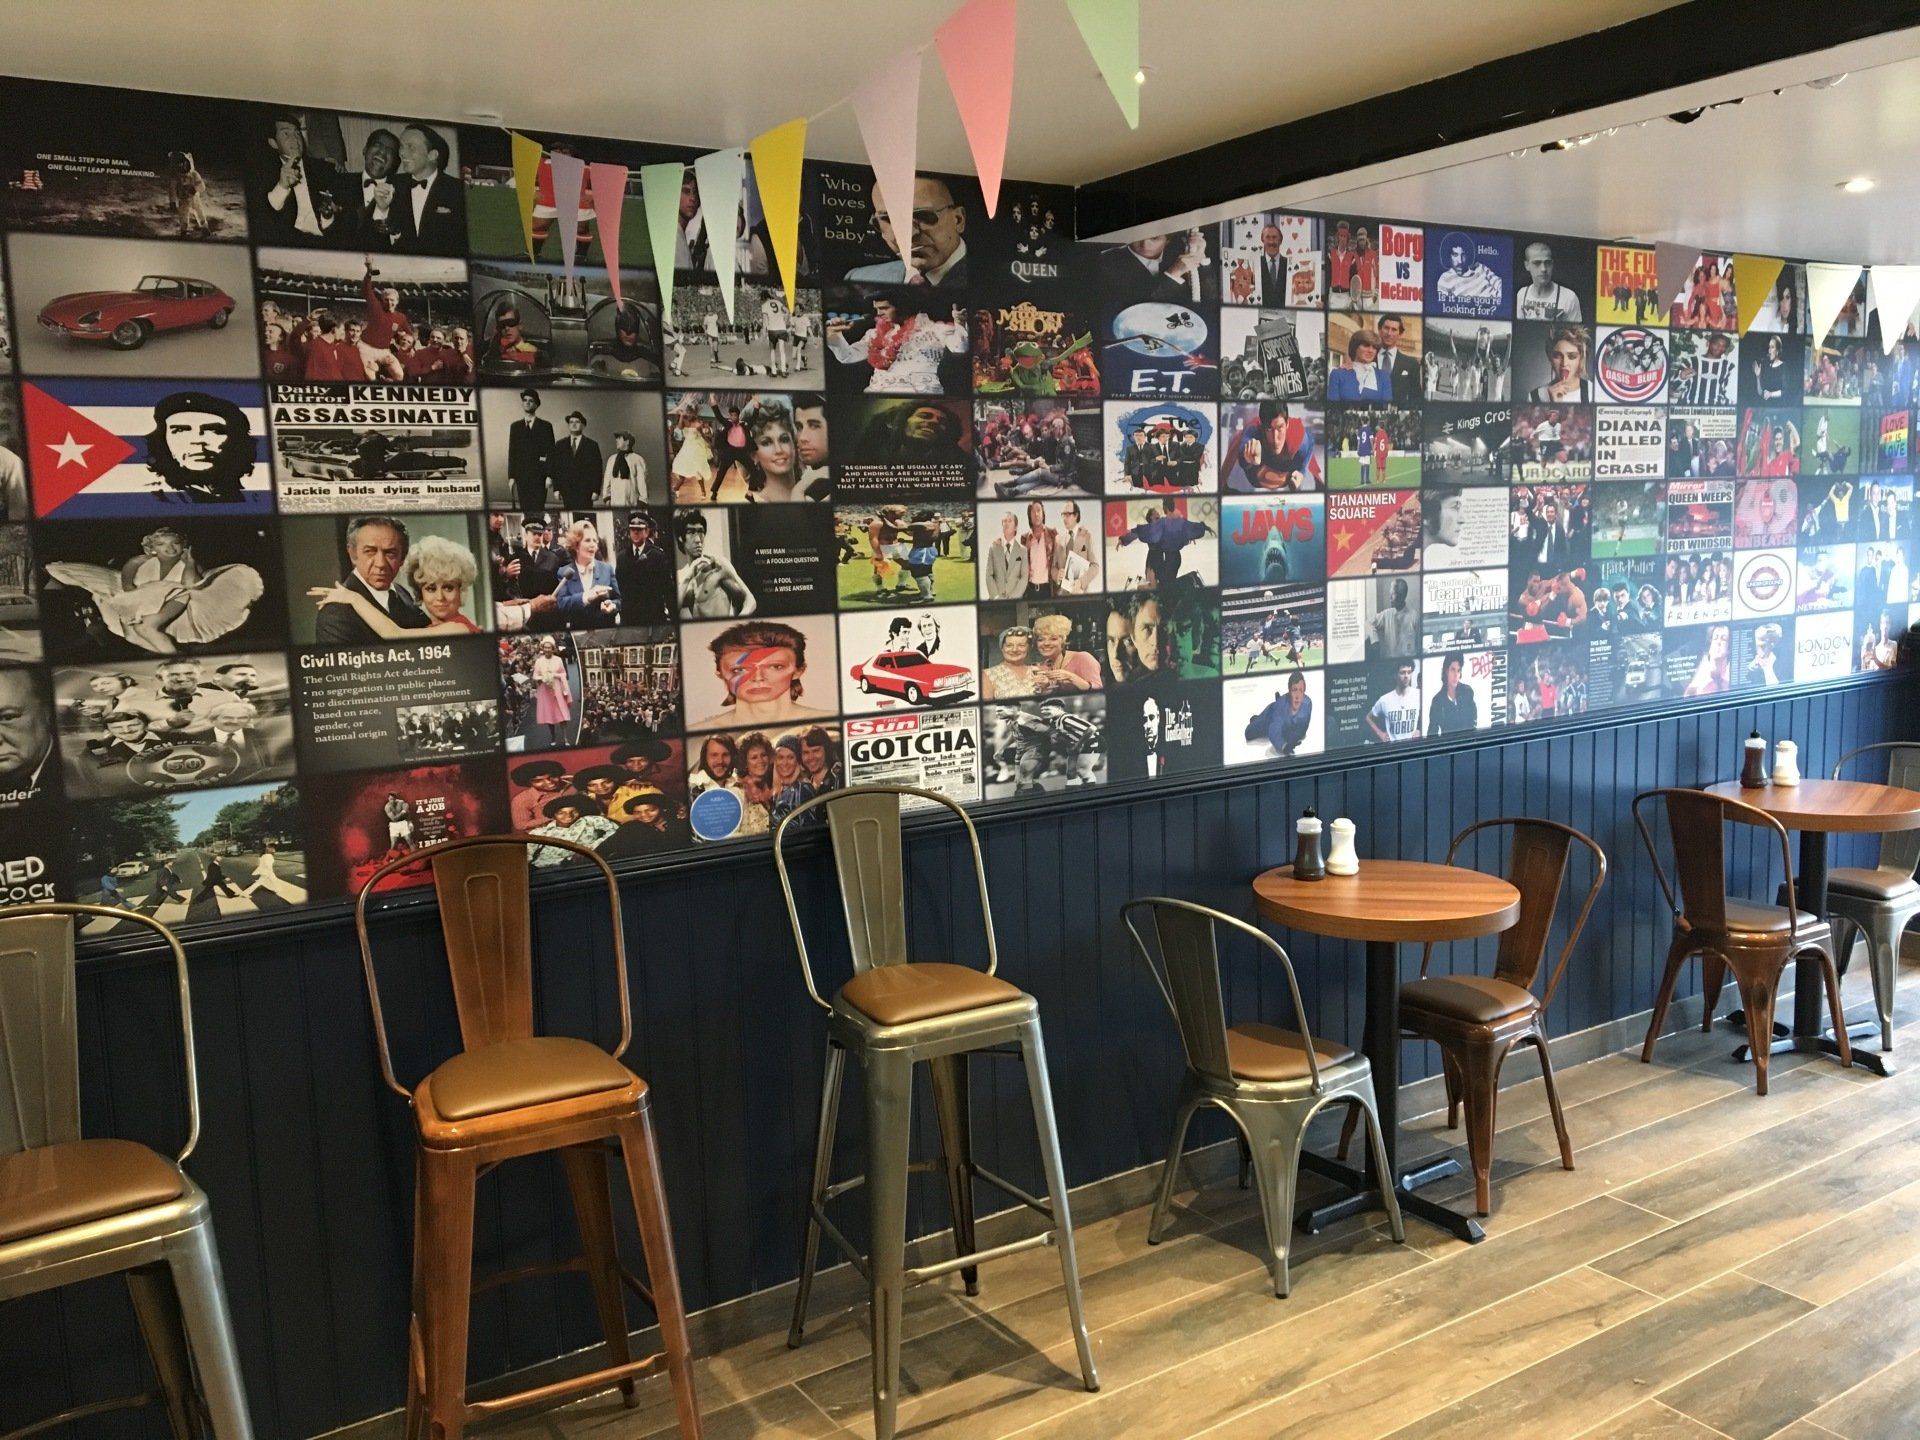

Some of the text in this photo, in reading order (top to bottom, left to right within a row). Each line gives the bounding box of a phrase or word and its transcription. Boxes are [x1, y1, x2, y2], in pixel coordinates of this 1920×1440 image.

[53, 154, 77, 163] SMALL
[78, 156, 95, 164] STEP
[111, 159, 130, 167] MAN,
[47, 163, 63, 171] ONE
[64, 164, 87, 173] GIANT
[87, 166, 106, 174] LEAP
[822, 193, 866, 209] loves
[835, 214, 854, 226] ya
[1381, 225, 1424, 262] Borg
[1477, 245, 1500, 256] Hello.
[1600, 248, 1630, 272] THE
[1011, 260, 1058, 283] QUEEN
[1438, 291, 1502, 307] Is it me you're
[1442, 303, 1497, 316] looking for?
[1262, 333, 1297, 361] SUPPORT
[1276, 356, 1295, 374] THE
[1130, 368, 1197, 394] E.T.
[1605, 369, 1631, 385] OASIS
[1637, 370, 1658, 384] BLUR
[277, 385, 331, 395] Daily
[1271, 371, 1304, 398] MINERS
[277, 393, 346, 403] Mirror
[352, 385, 473, 403] KENNEDY
[274, 407, 479, 424] ASSASSINATED
[1598, 420, 1662, 432] DIANA
[1361, 431, 1367, 443] 9
[1598, 436, 1662, 446] KILLED
[1379, 439, 1385, 452] 6
[1597, 450, 1616, 460] IN
[1597, 463, 1658, 475] CRASH
[283, 484, 481, 496] Jackie holds dying husband
[1669, 482, 1704, 490] Mirror
[1329, 493, 1397, 507] TIANANMEN
[1668, 491, 1732, 504] QUEEN WEEPS
[1329, 506, 1376, 520] SQUARE
[1231, 507, 1315, 545] JAWS
[1668, 537, 1732, 551] FOR WINDSOR
[793, 556, 819, 564] QUESTION
[1429, 584, 1501, 602] Tear Down
[1437, 599, 1467, 615] This
[300, 645, 451, 669] Civil Rights Act, 1964
[303, 667, 444, 685] The Civil Rights Act declared:
[311, 678, 456, 697] no segregation in public places
[312, 701, 325, 709] no
[327, 695, 399, 708] discrimination
[413, 688, 471, 702] employment
[313, 708, 382, 720] based on race,
[1387, 708, 1417, 721] FEED THE
[314, 720, 364, 733] gender, or
[849, 720, 916, 736] Sun
[1389, 720, 1415, 735] WORLD
[315, 729, 388, 743] national origin
[850, 728, 976, 762] GOTCHA
[921, 755, 937, 763] Our
[940, 753, 956, 761] lads
[923, 761, 956, 771] gunboat
[925, 766, 973, 777] hole cruiser
[428, 796, 445, 804] JUST
[416, 802, 446, 814] A JOB
